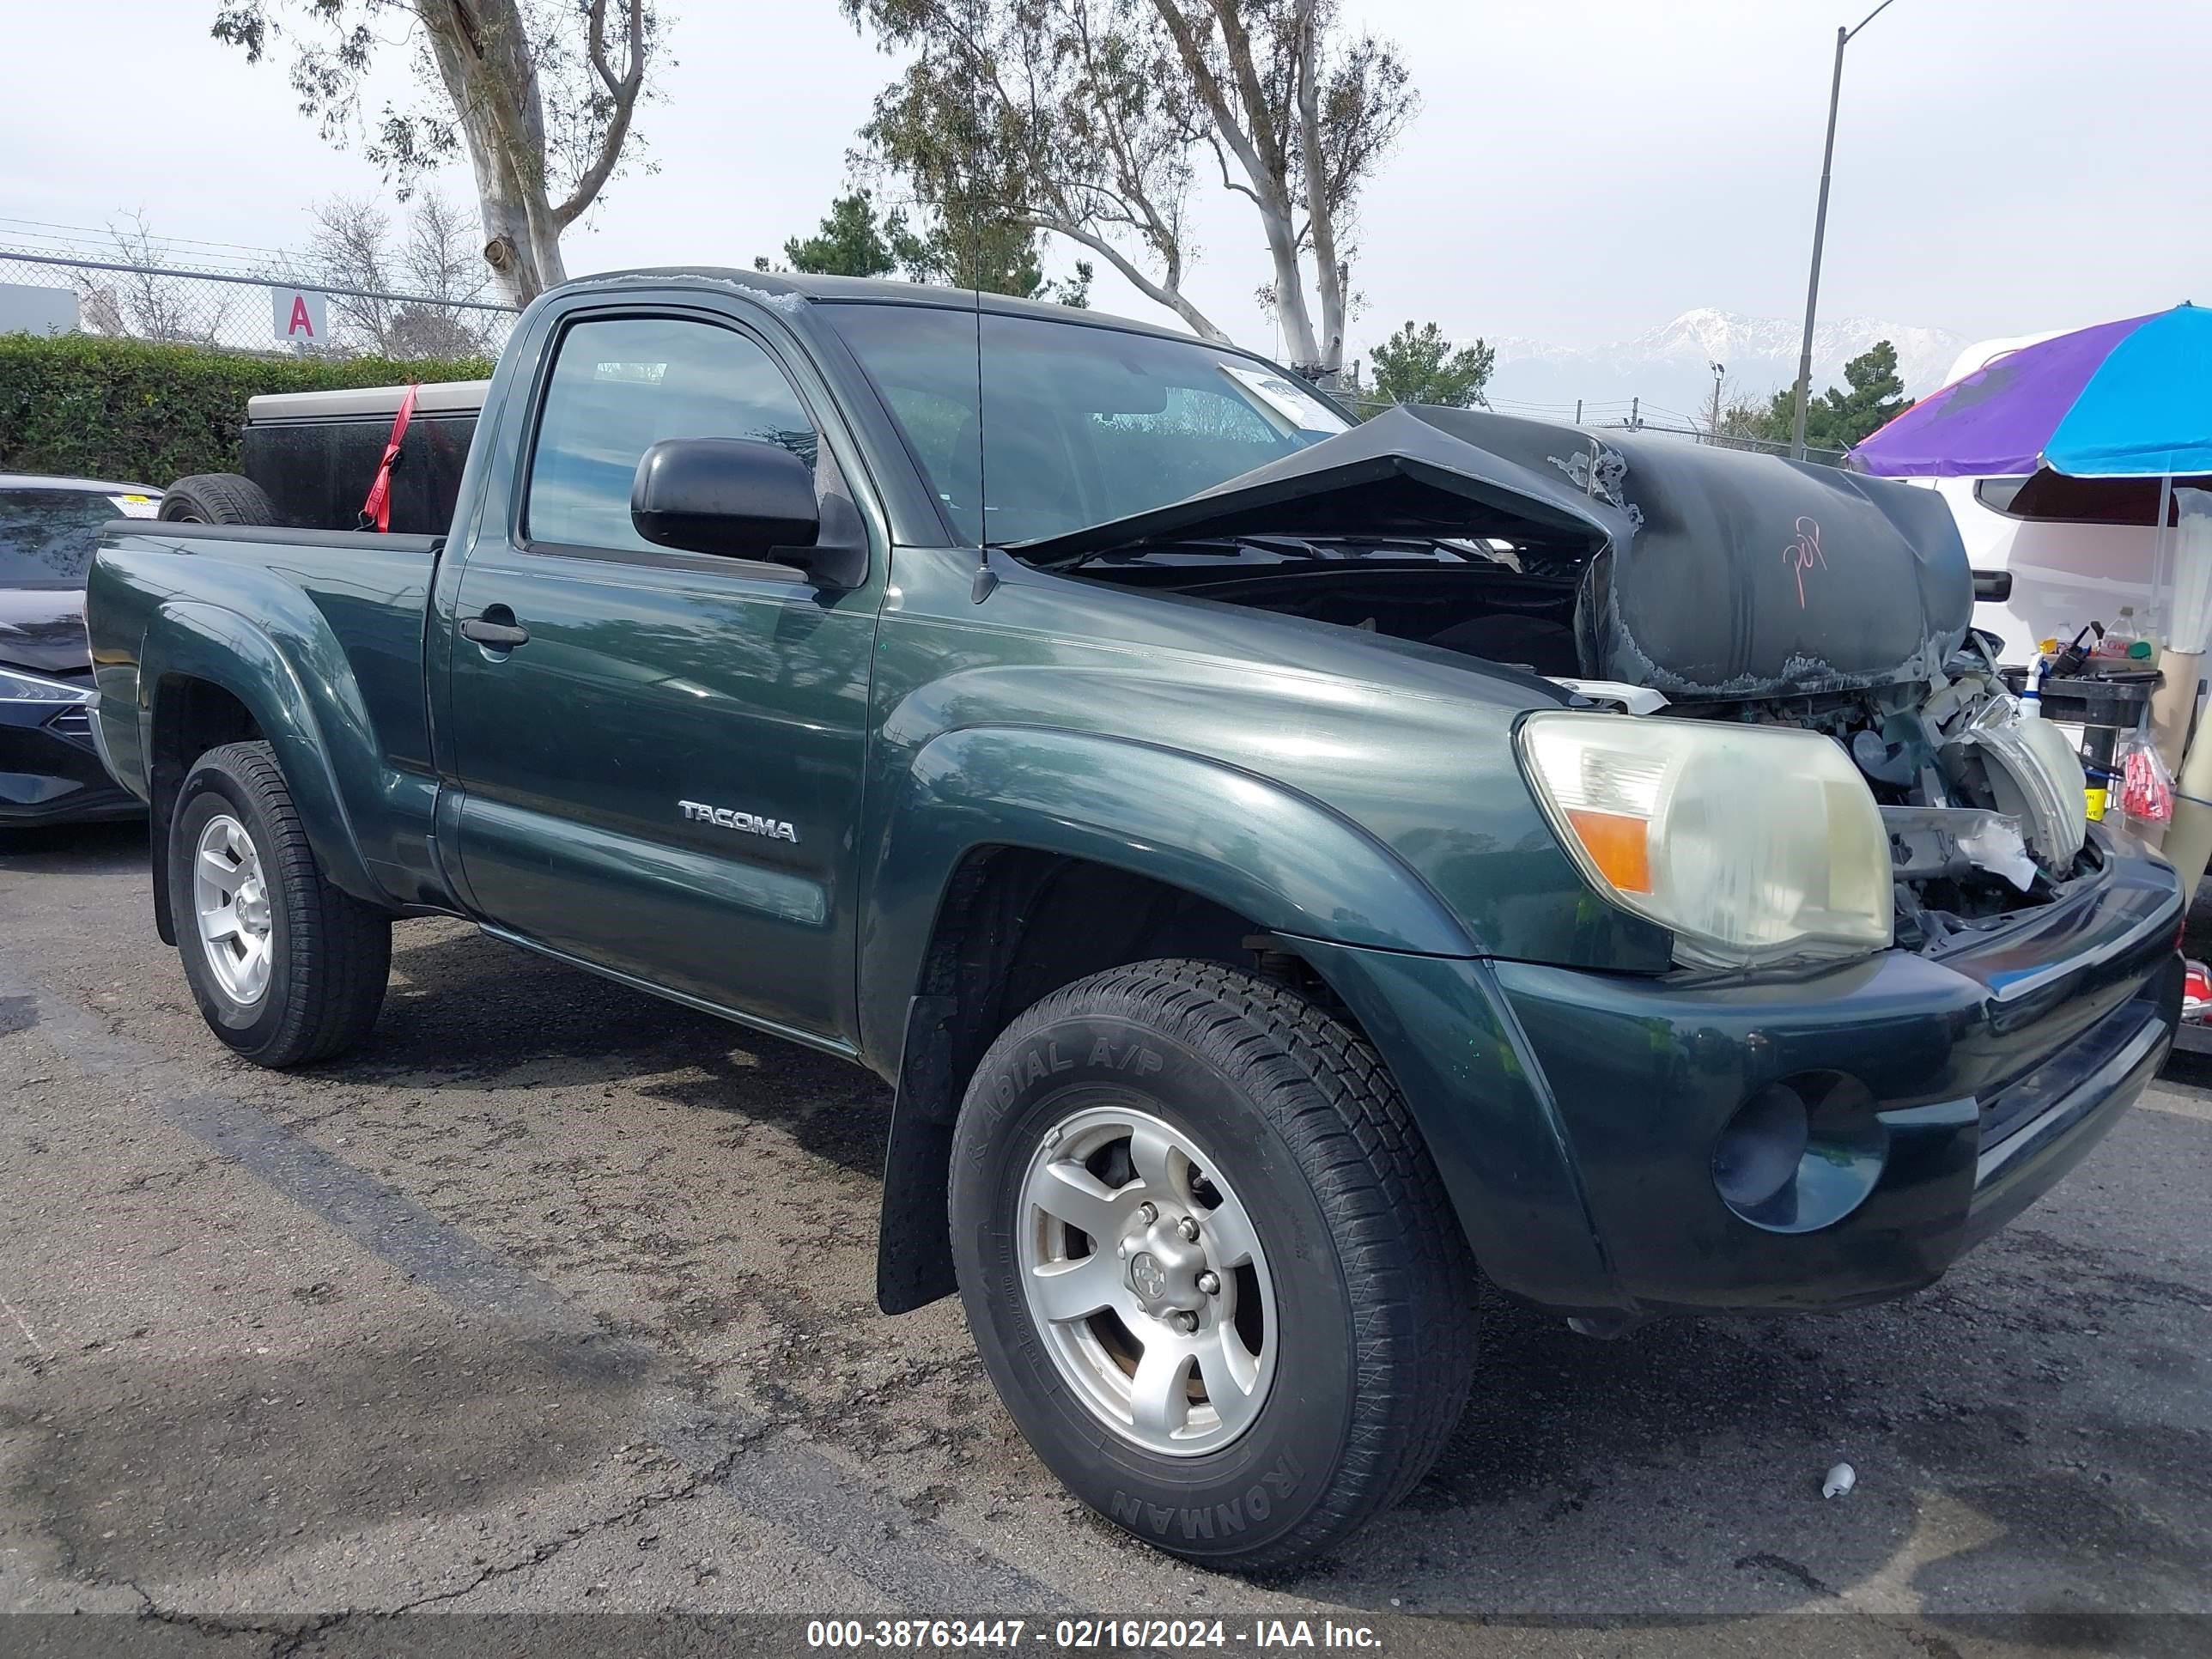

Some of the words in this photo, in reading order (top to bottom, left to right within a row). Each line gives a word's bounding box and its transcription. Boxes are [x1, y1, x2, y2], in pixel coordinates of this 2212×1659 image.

[289, 296, 314, 337] A
[678, 799, 799, 843] TACOMA
[967, 1042, 1073, 1174] RADIAL
[1086, 1036, 1164, 1076] A/P
[1110, 1445, 1305, 1539] IRONMAN
